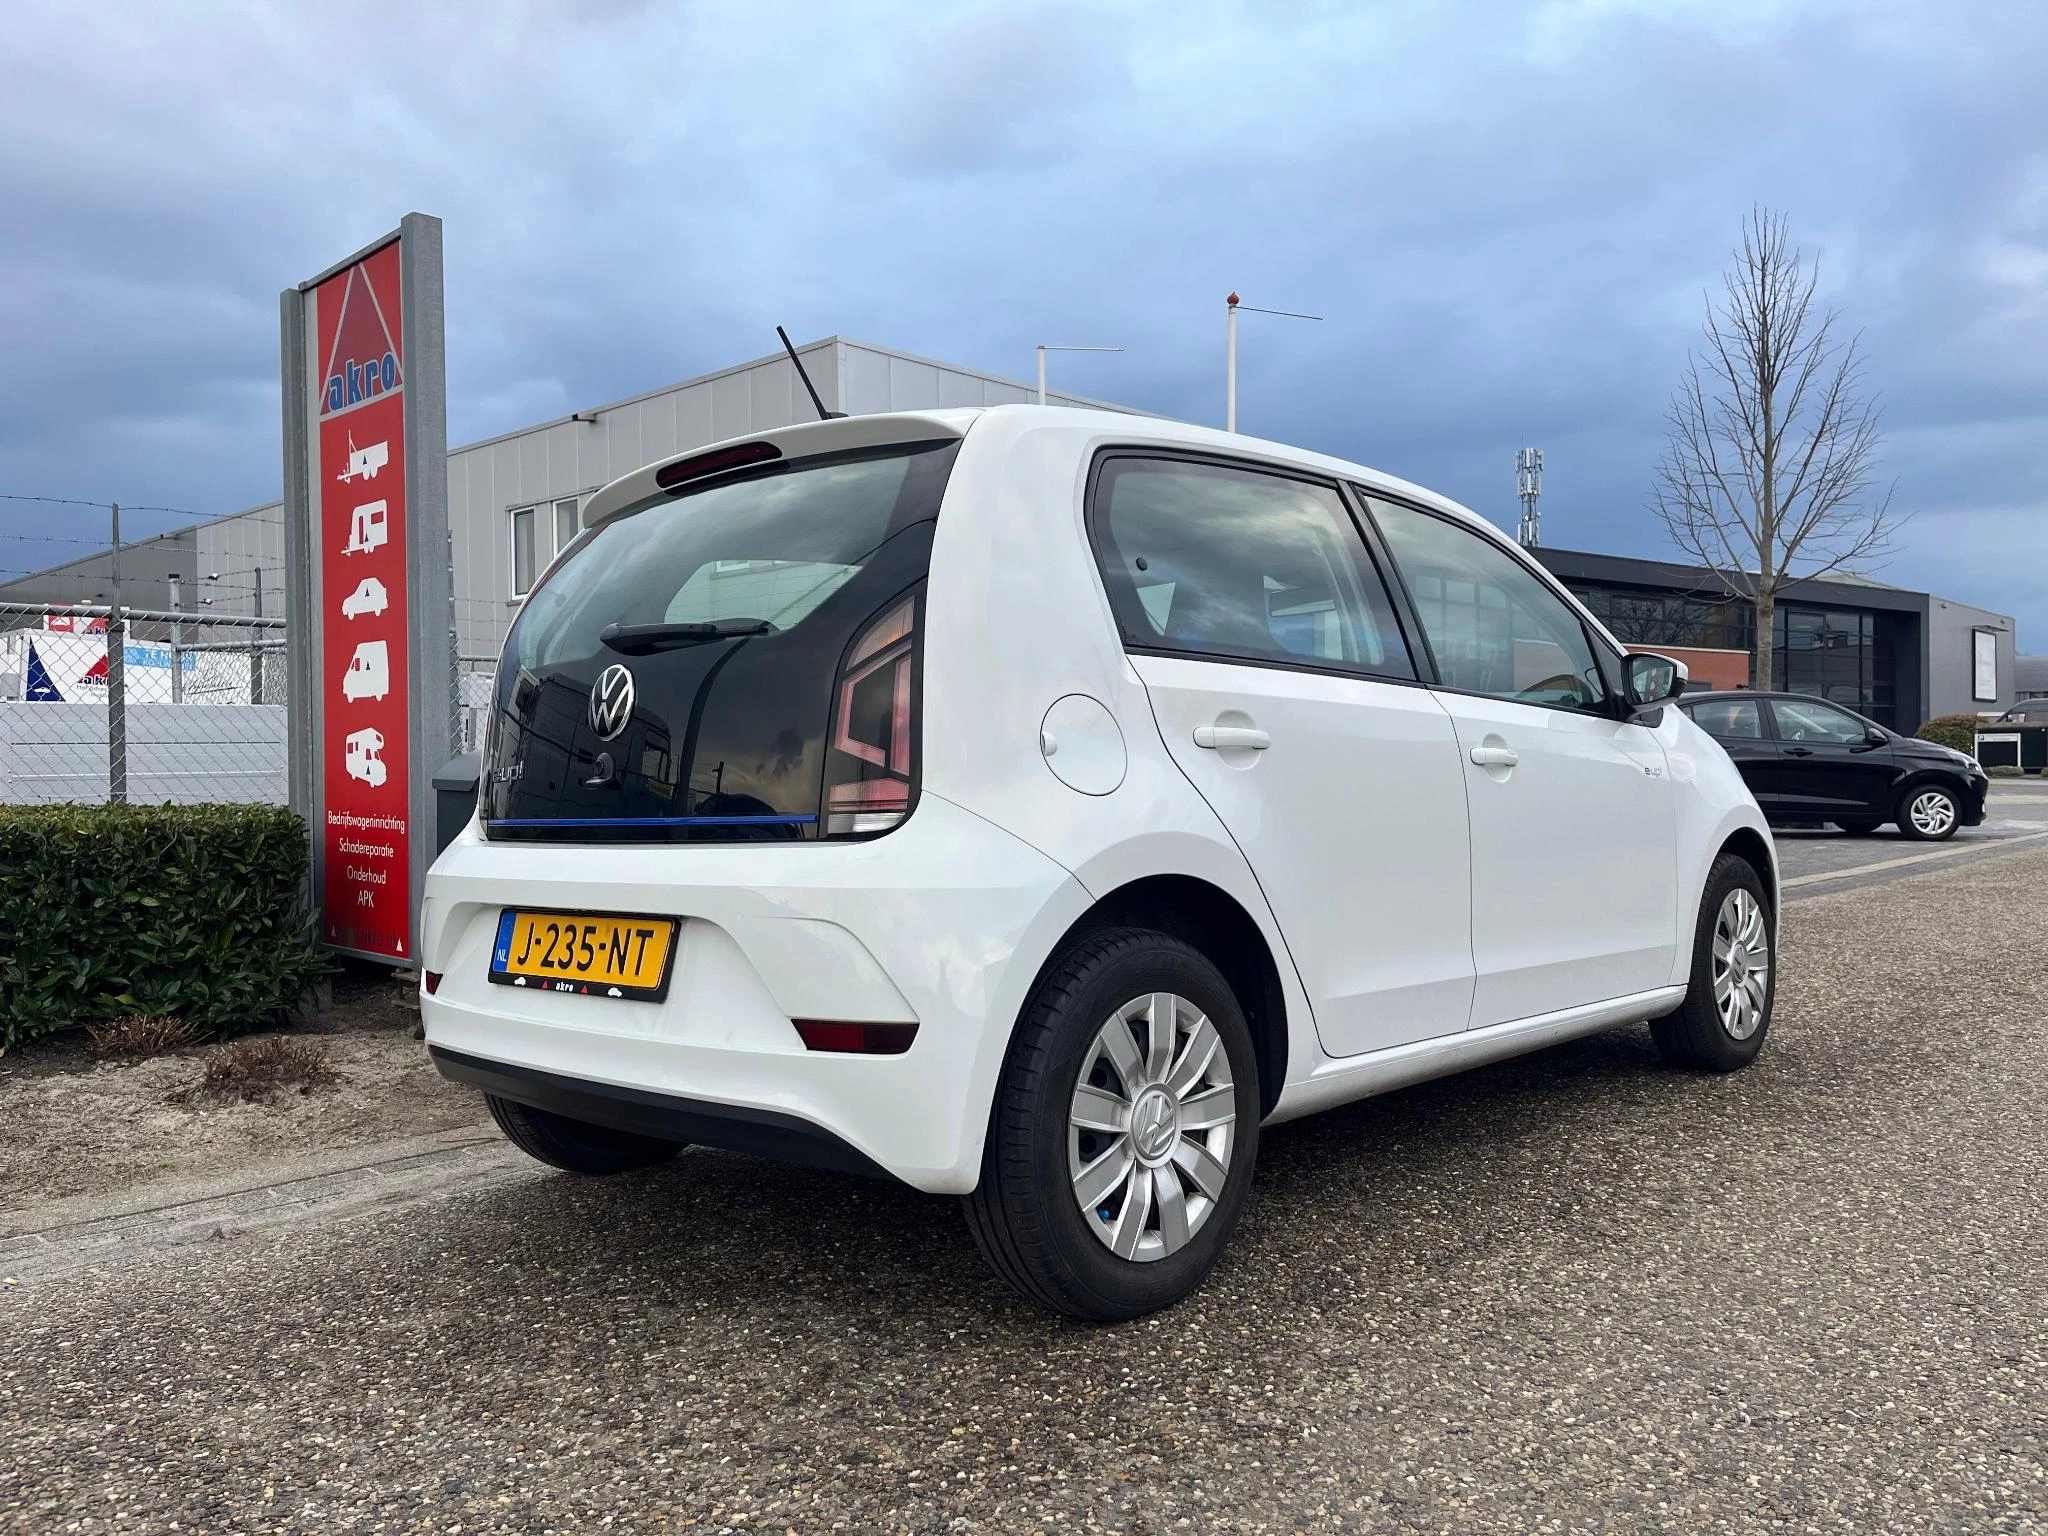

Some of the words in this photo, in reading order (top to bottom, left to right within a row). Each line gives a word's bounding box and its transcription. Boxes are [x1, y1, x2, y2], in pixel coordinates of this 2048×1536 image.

[328, 352, 396, 412] akro
[328, 810, 405, 834] Bedrijfswageninrichting
[339, 838, 394, 859] Schadereparatie
[346, 865, 386, 885] Onderhoud
[357, 890, 375, 908] APK
[496, 948, 507, 962] NL
[517, 921, 655, 977] J-235-NT
